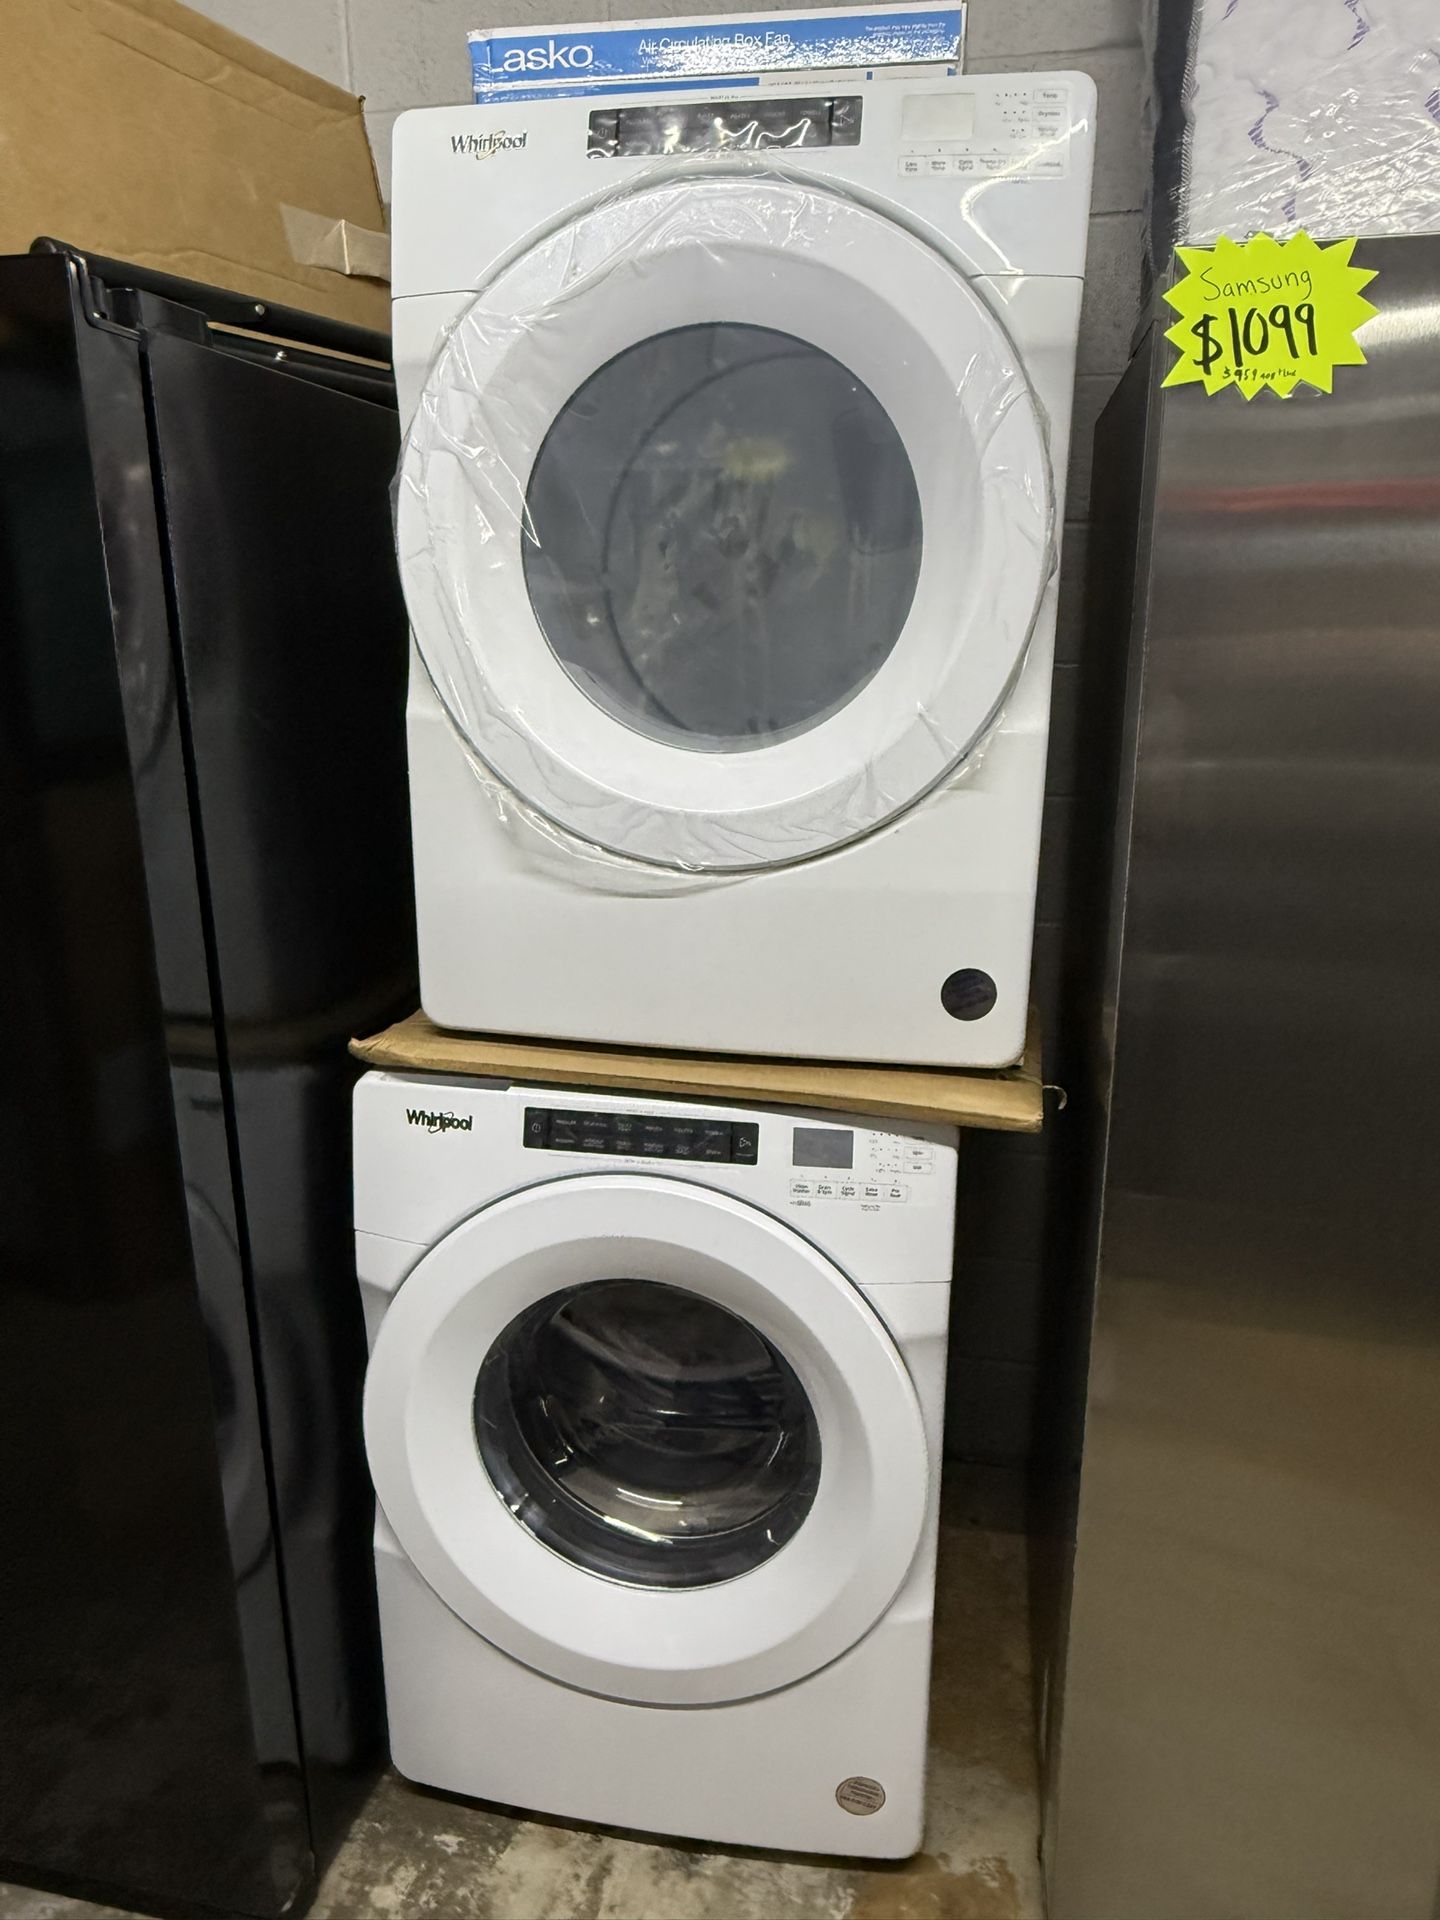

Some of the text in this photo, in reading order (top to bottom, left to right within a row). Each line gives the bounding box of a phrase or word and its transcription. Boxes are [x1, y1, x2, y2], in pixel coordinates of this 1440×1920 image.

[638, 31, 791, 55] Air Circulating Box Fan
[451, 131, 527, 158] Whirlpool
[1200, 266, 1313, 301] Samsung
[1191, 303, 1318, 376] $1099
[406, 1108, 473, 1134] Whirlpool
